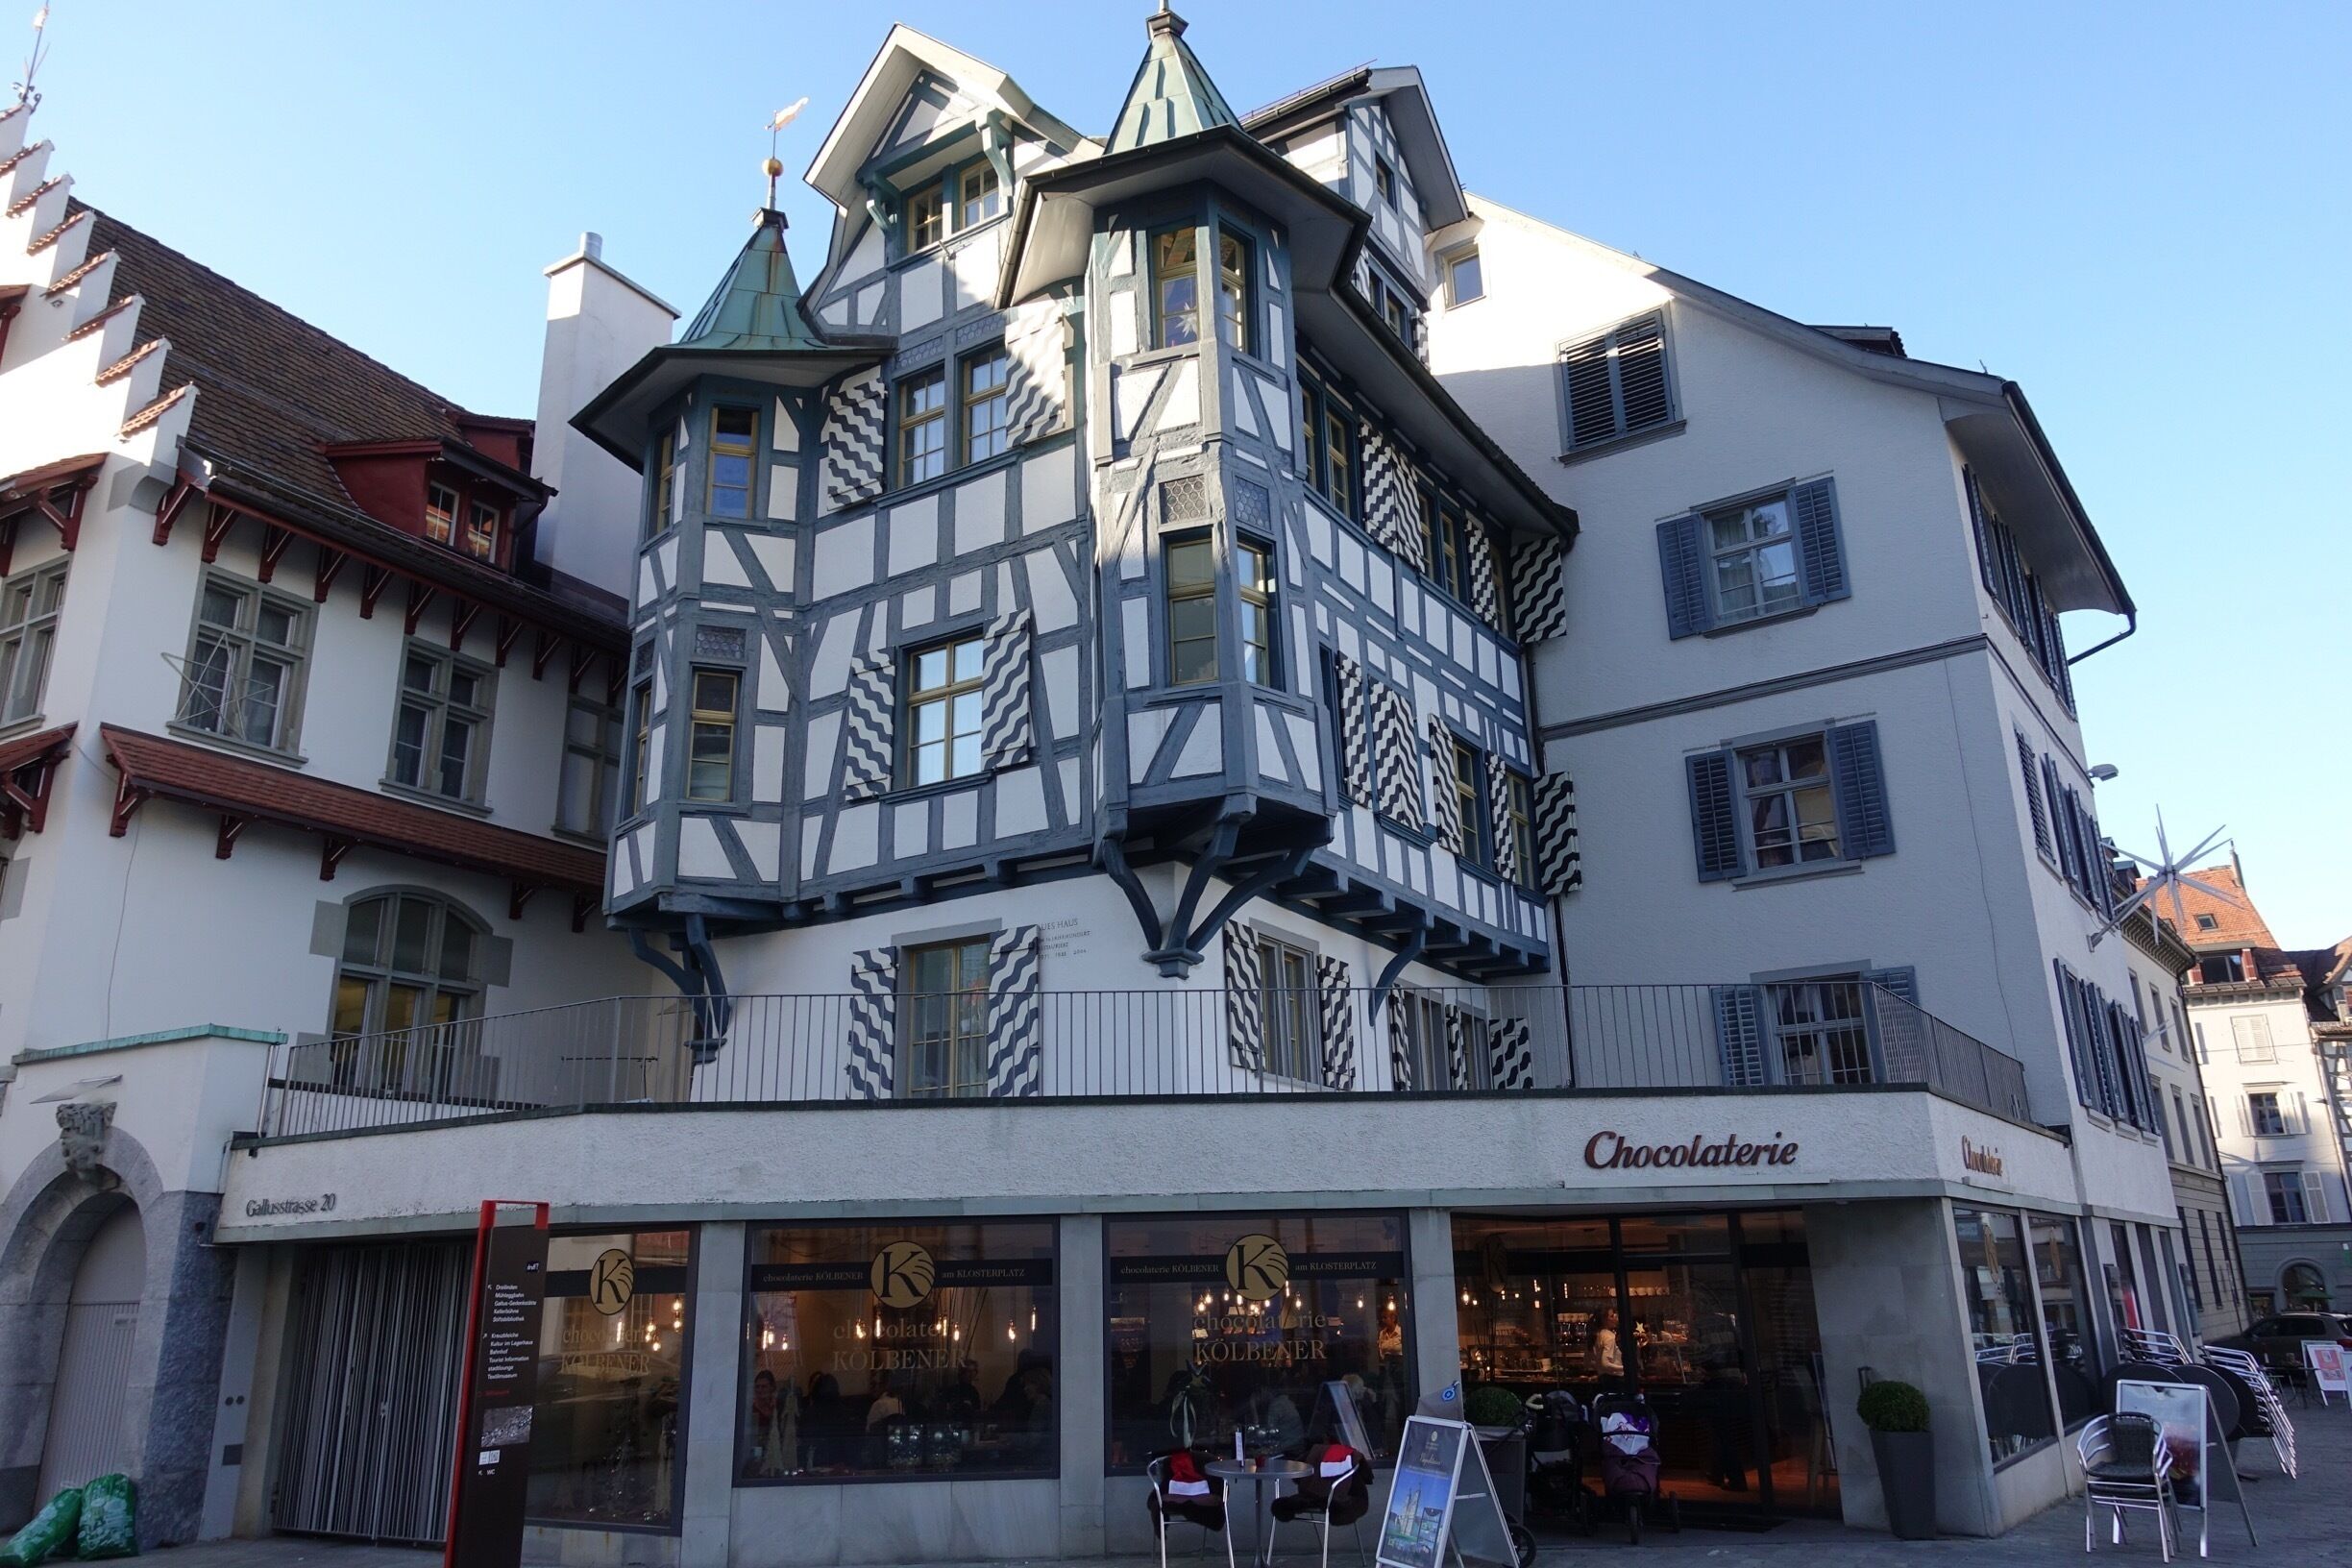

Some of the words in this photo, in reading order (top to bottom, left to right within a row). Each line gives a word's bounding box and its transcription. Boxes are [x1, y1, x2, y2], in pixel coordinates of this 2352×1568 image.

[1057, 919, 1078, 929] HAUS
[1584, 1131, 1799, 1169] Chocolaterie
[246, 1198, 317, 1217] Gallusstrasse
[320, 1192, 336, 1212] 20
[957, 1268, 1024, 1278] KLOSTERPLATZ
[1120, 1265, 1170, 1274] chocolaterie
[1172, 1263, 1219, 1273] KÖLBENER
[1310, 1262, 1377, 1270] KLOSTERPLATZ
[763, 1273, 814, 1282] chocolaterie
[816, 1269, 864, 1281] KÖLBENER
[1193, 1311, 1326, 1332] chocolatrie
[1195, 1337, 1328, 1362] KÖLBENER
[832, 1347, 968, 1371] KÖLBENER
